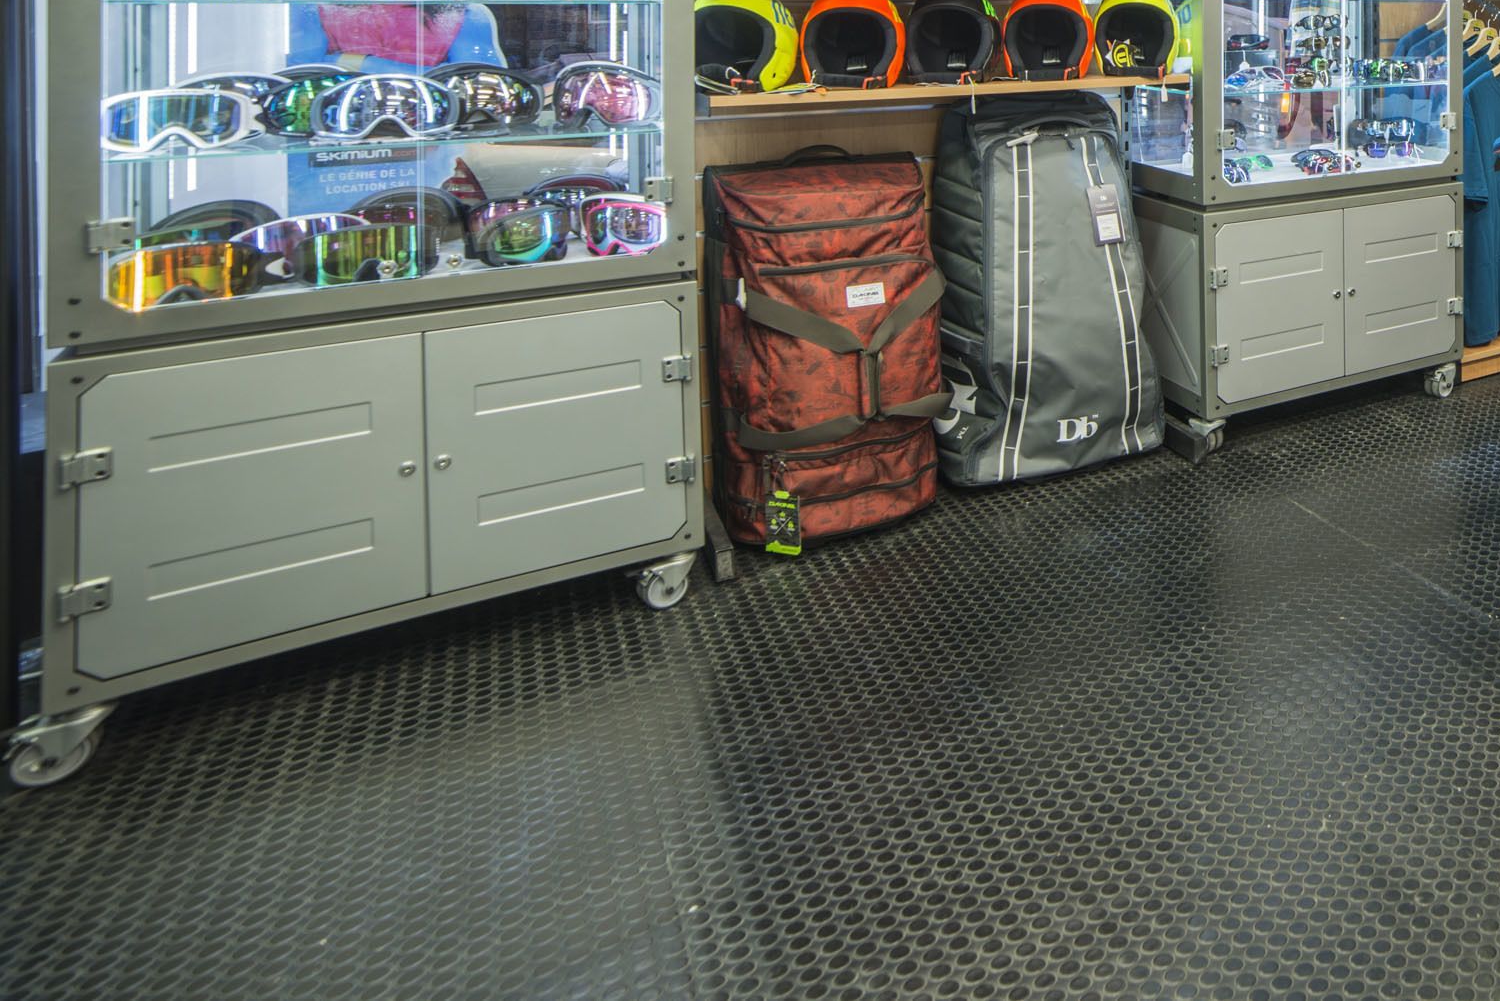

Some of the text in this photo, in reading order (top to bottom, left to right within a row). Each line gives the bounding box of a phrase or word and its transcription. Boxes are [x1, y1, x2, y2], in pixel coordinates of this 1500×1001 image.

[319, 173, 336, 183] LE
[380, 169, 397, 178] DE
[400, 167, 416, 177] LA
[325, 182, 387, 195] LOCATION
